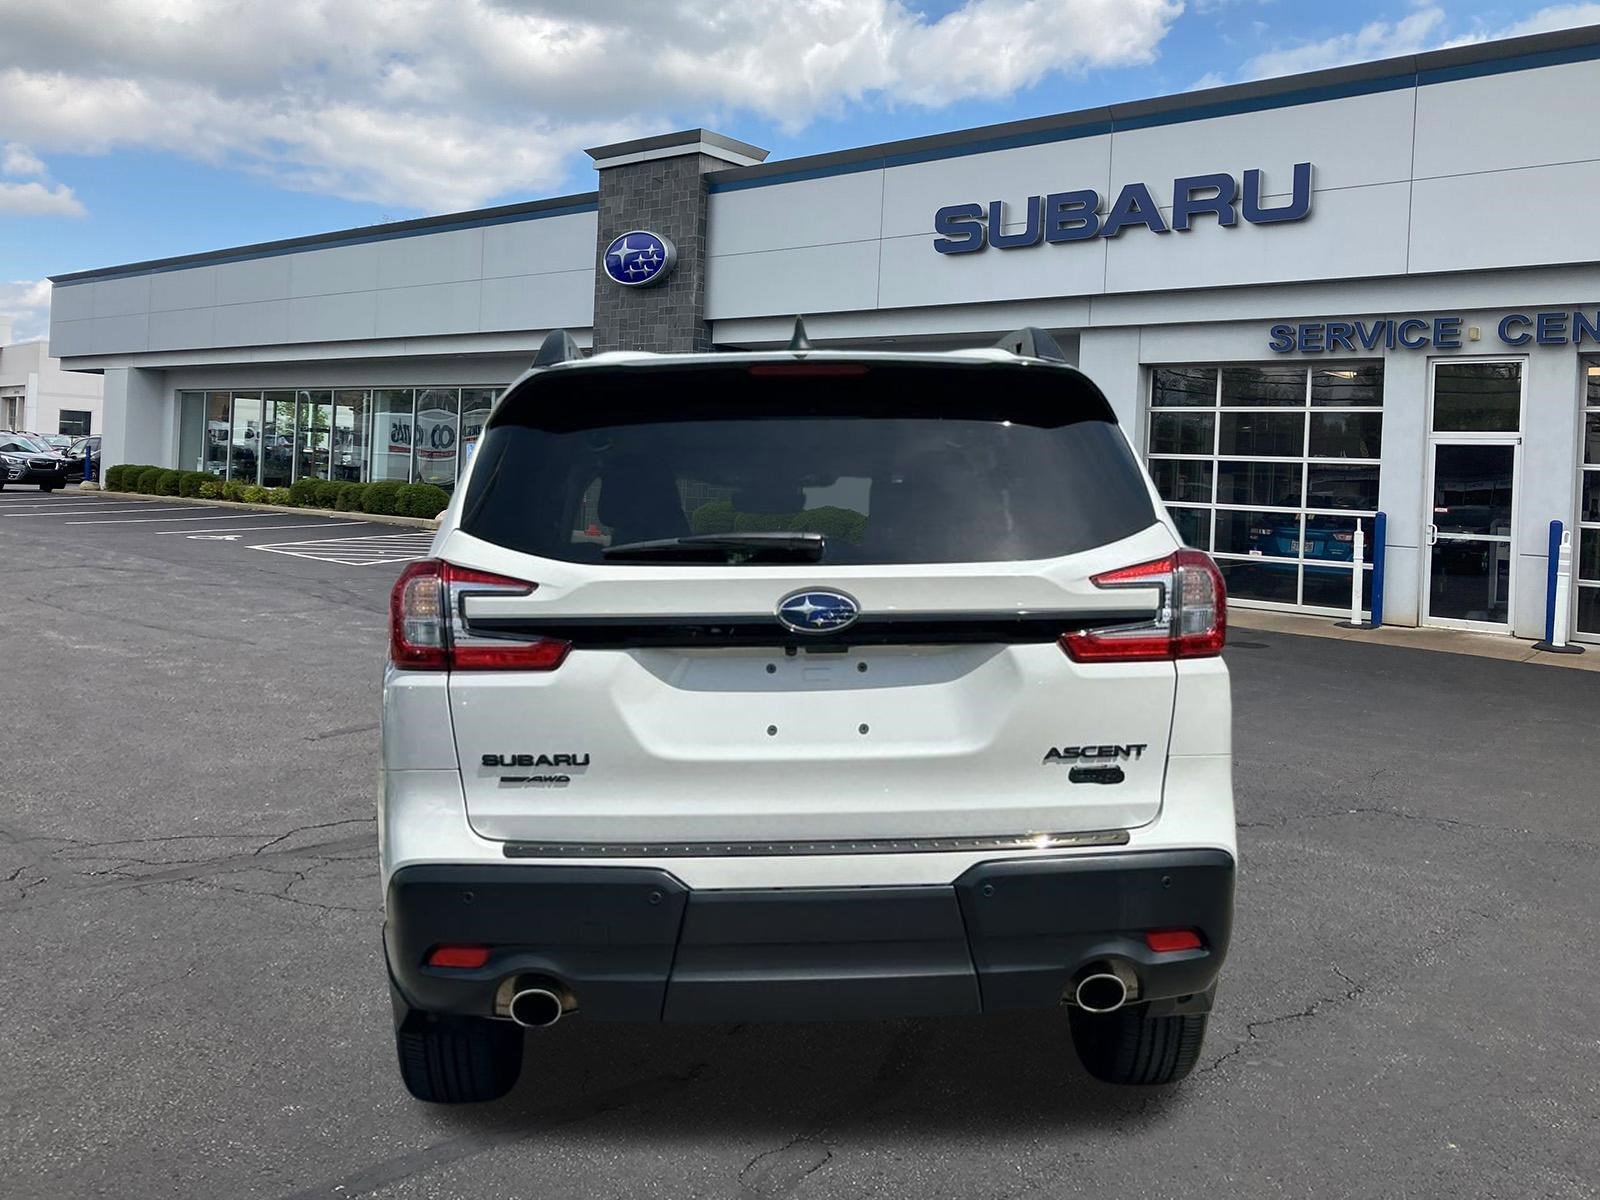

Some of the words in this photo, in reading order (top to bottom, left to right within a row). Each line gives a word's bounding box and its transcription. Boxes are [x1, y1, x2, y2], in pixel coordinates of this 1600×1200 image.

[933, 161, 1313, 255] SUBARU
[1268, 317, 1463, 352] SERVICE
[481, 753, 590, 766] SUBARU
[1043, 744, 1147, 760] ASCENT
